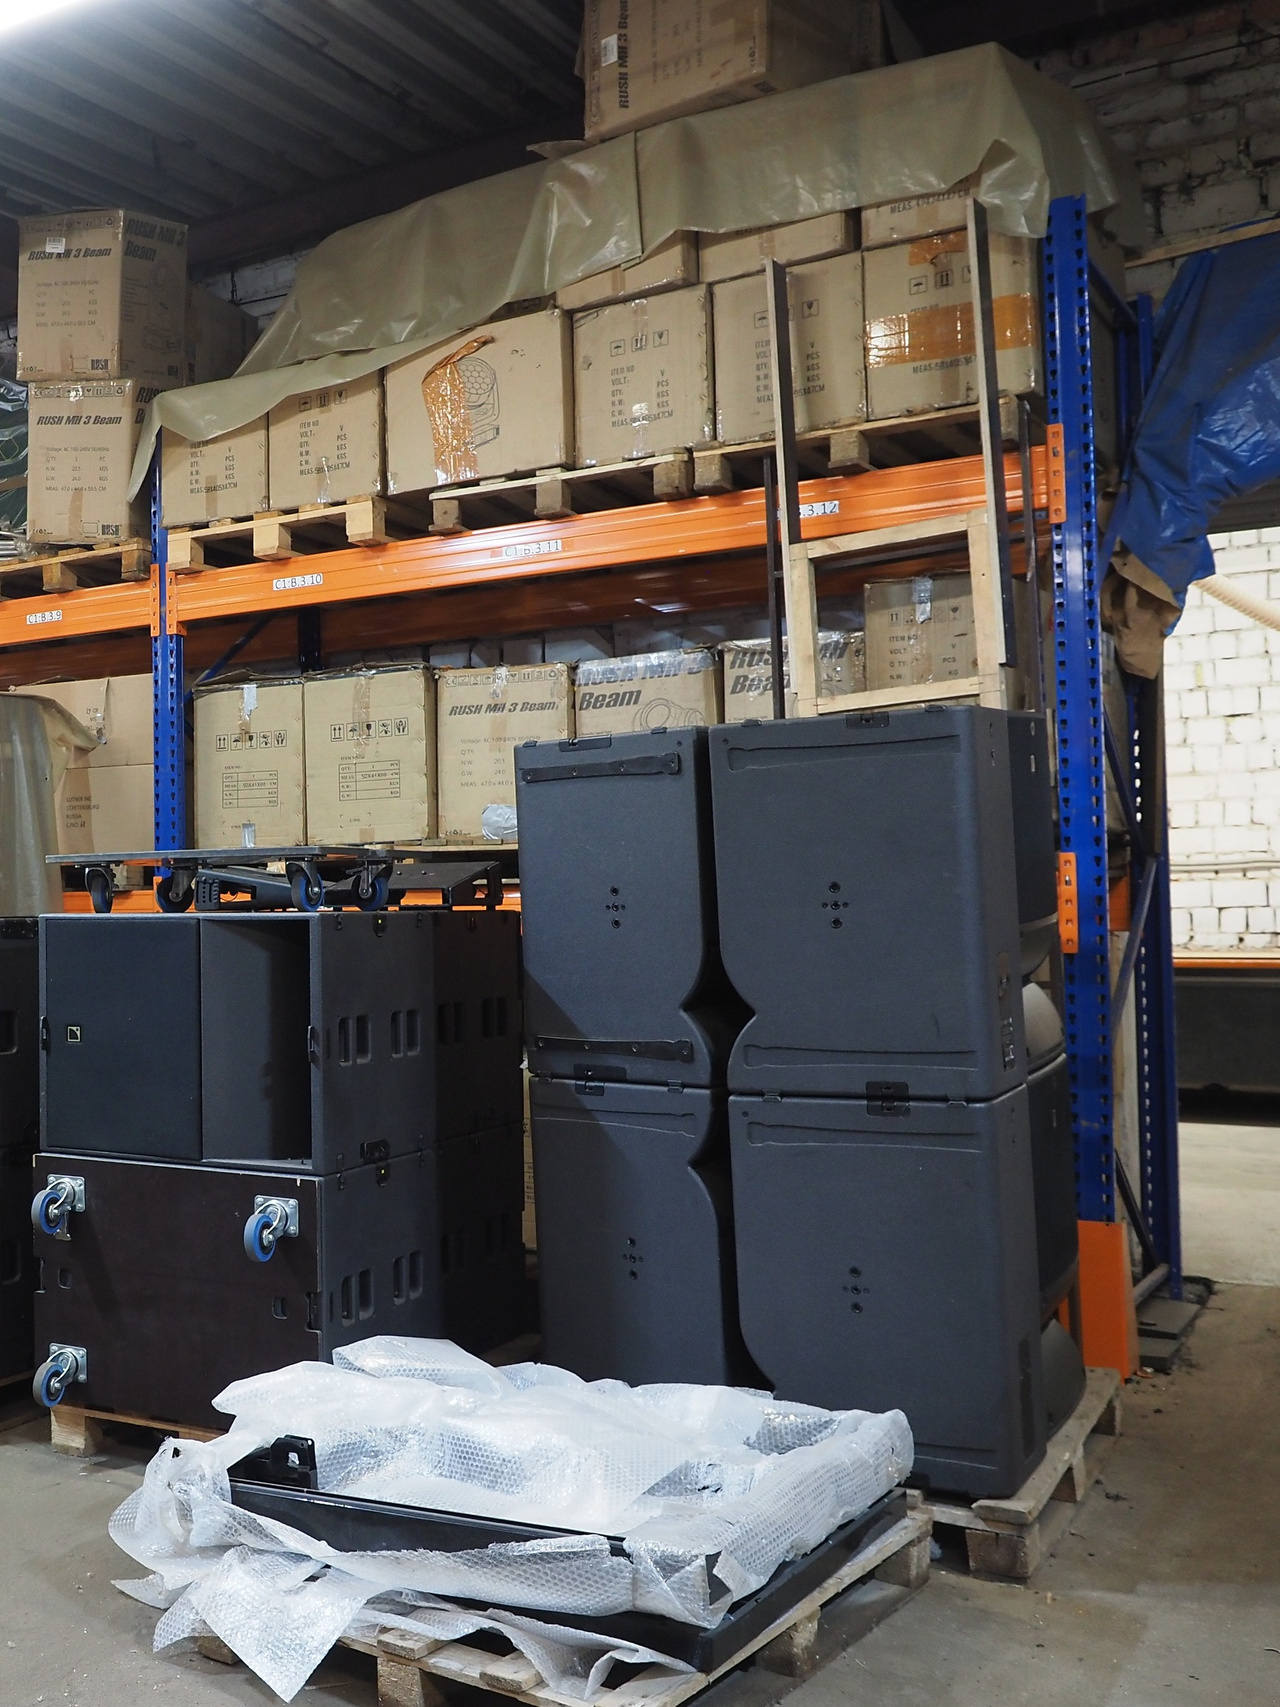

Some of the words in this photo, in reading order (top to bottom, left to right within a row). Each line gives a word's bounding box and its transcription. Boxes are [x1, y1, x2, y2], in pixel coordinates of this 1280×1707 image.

[126, 218, 157, 239] RUSH
[176, 230, 185, 246] 3
[27, 250, 53, 261] RUSH
[73, 248, 81, 258] 3
[82, 247, 112, 258] Beam
[124, 241, 156, 262] Beam
[656, 380, 669, 388] PCS
[37, 416, 64, 426] RUSH
[65, 415, 83, 426] MH
[84, 415, 92, 425] 3
[93, 415, 122, 425] Beam
[337, 433, 347, 441] PCS
[889, 635, 906, 643] ITEM
[579, 689, 642, 711] Beam
[449, 704, 481, 716] RUSH
[485, 703, 507, 714] MH
[508, 702, 519, 713] 3
[520, 701, 556, 712] Beam
